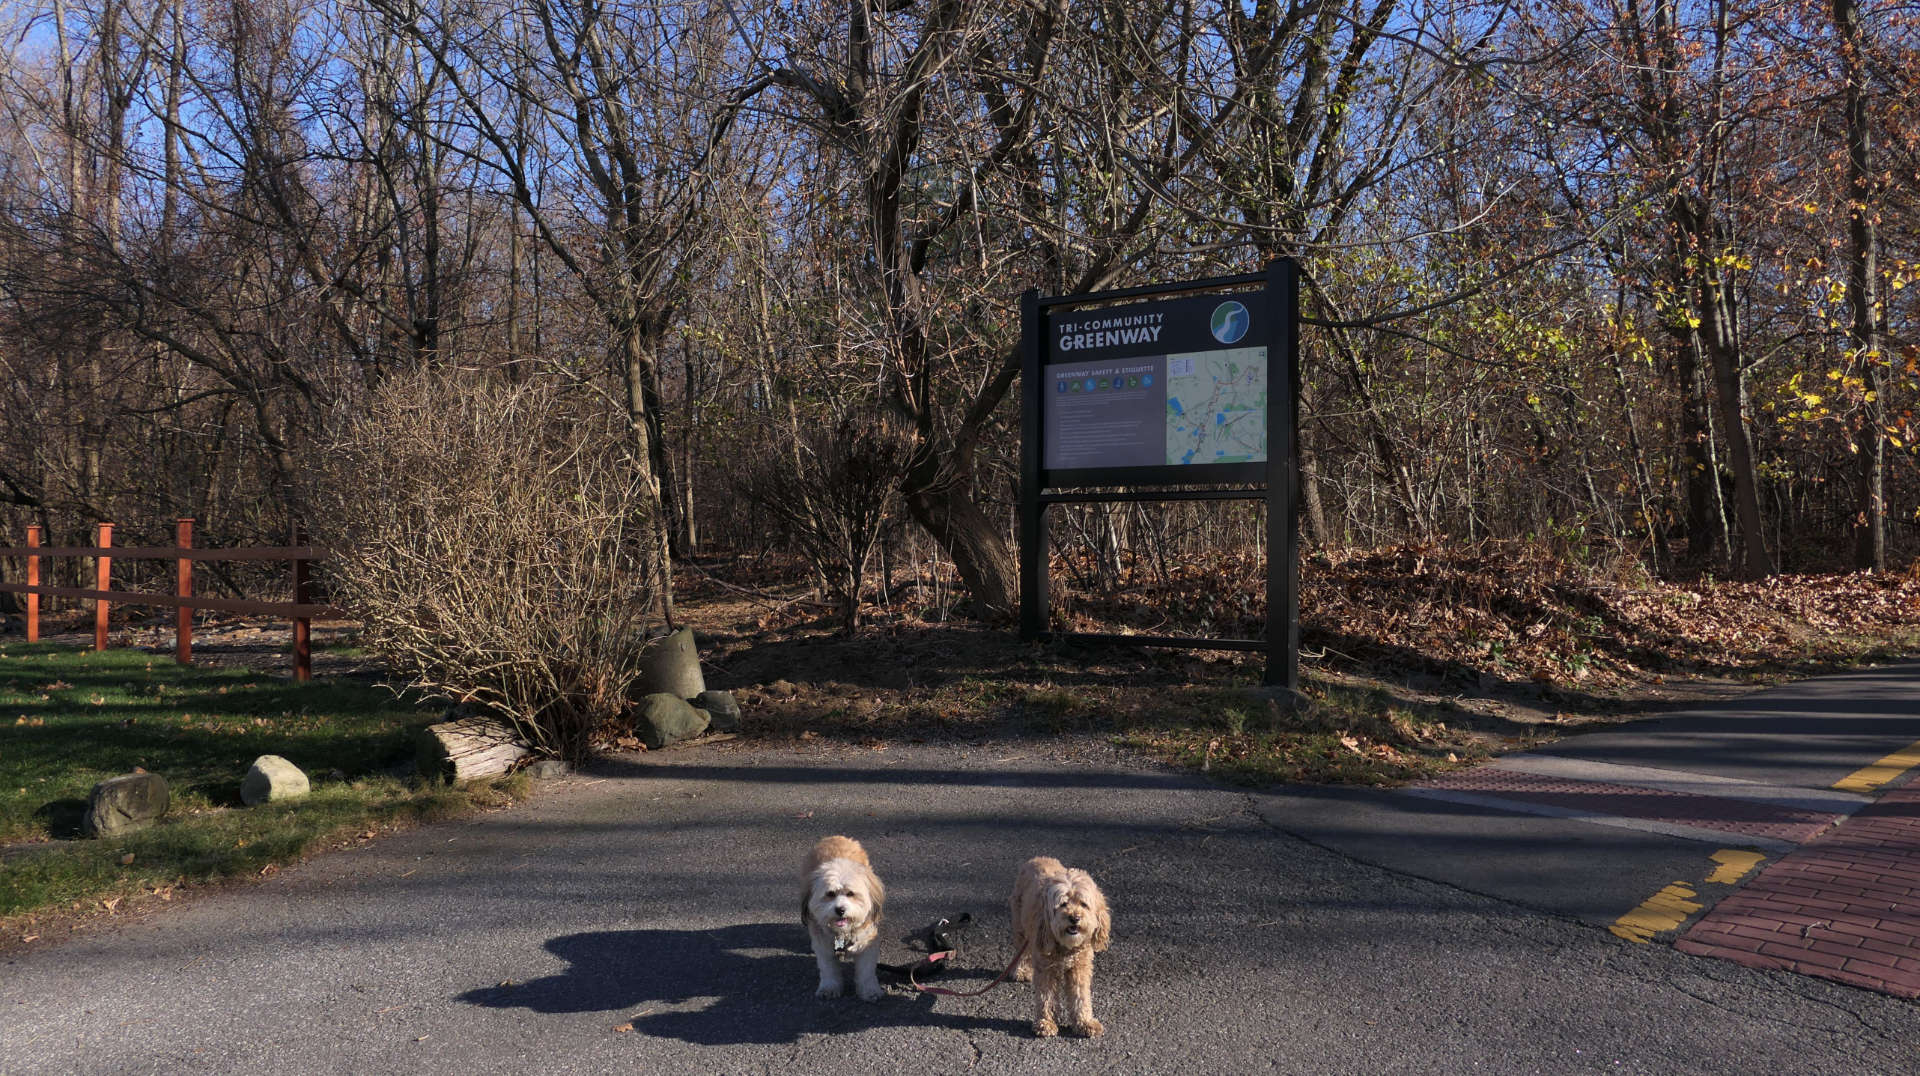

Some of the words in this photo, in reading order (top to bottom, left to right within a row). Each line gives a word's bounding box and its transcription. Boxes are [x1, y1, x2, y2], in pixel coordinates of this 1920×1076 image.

[1059, 313, 1164, 334] TRI-COMMUNITY
[1059, 326, 1162, 351] GREENWAY
[1056, 370, 1089, 379] GREENWAY
[1091, 368, 1112, 377] SAFETY
[1122, 365, 1154, 375] ETIQUETTE
